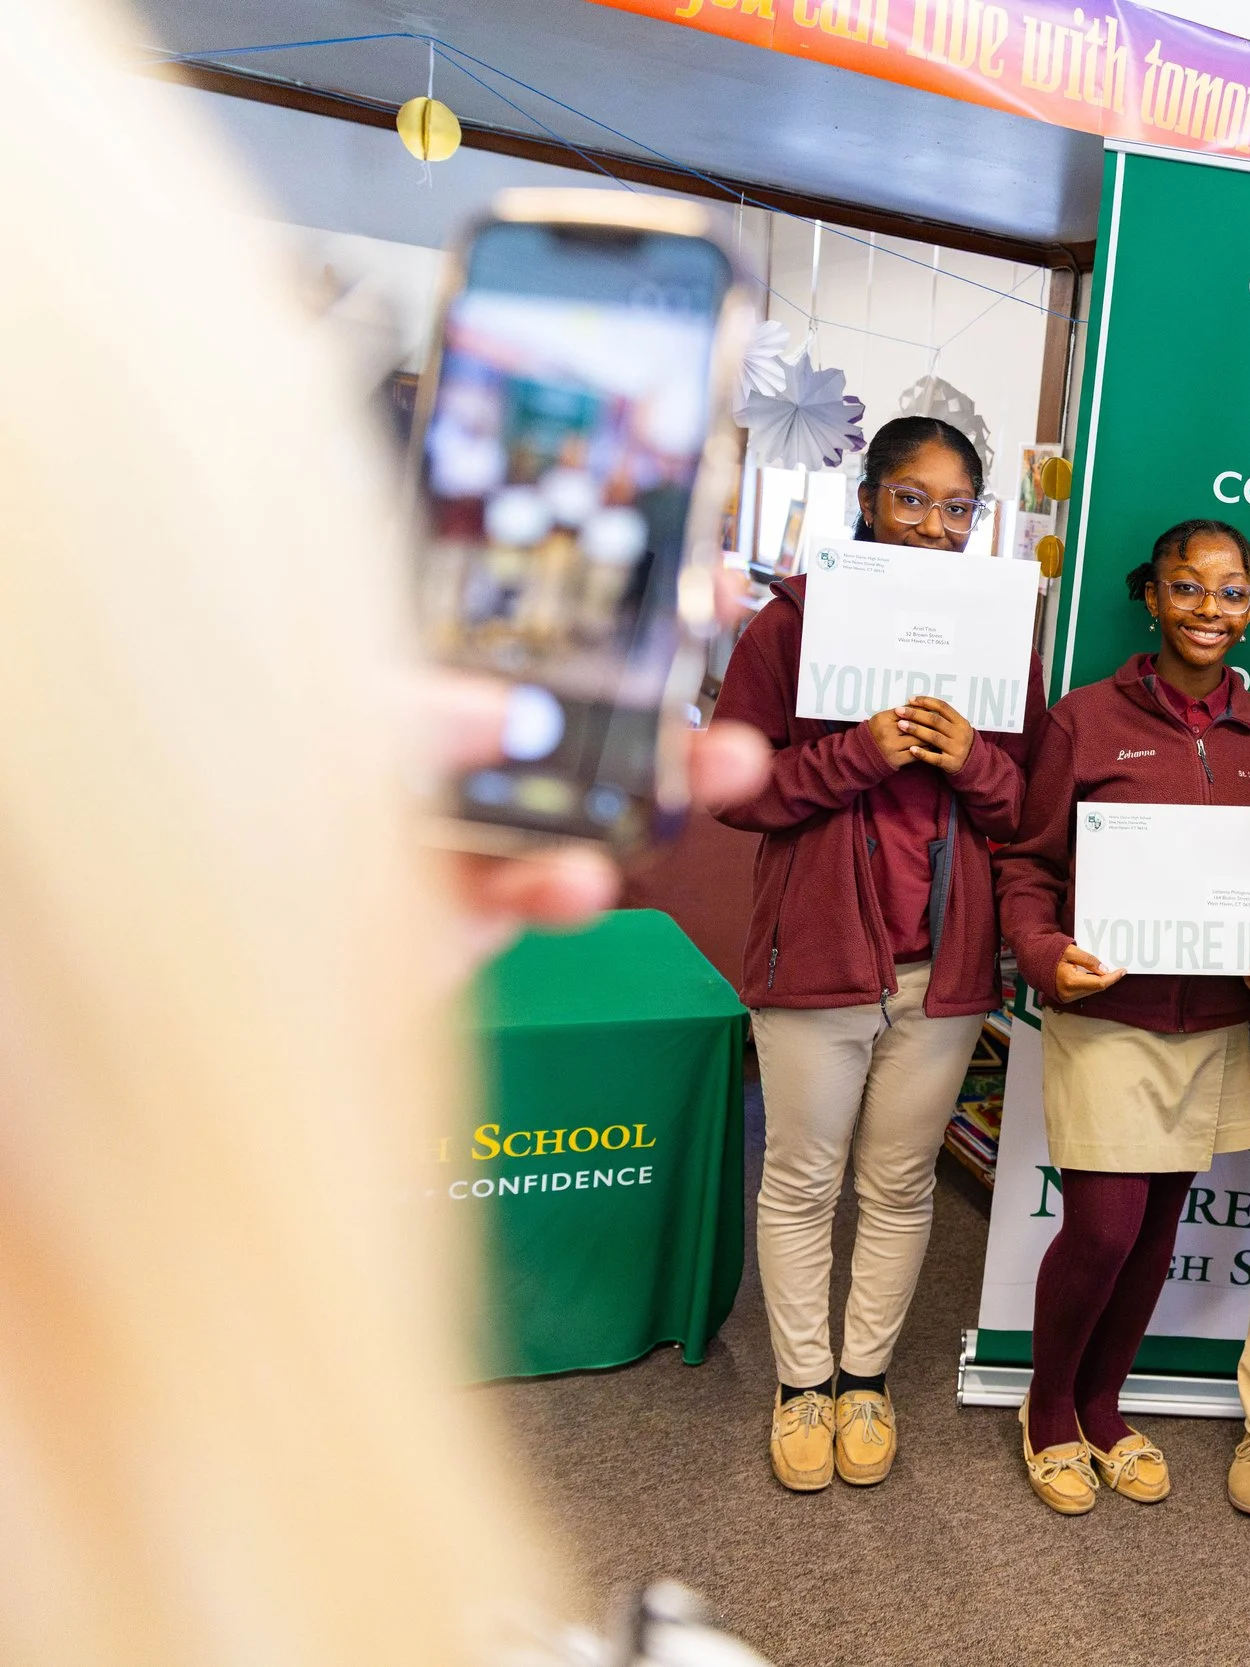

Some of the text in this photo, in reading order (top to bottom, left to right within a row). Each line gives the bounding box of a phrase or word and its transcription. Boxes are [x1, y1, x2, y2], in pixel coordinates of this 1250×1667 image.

[1021, 8, 1128, 116] with
[967, 675, 1020, 728] IN!
[1083, 918, 1224, 970] YOU'RE
[471, 1123, 658, 1160] SCHOOL
[448, 1166, 654, 1200] CONFIDENCE
